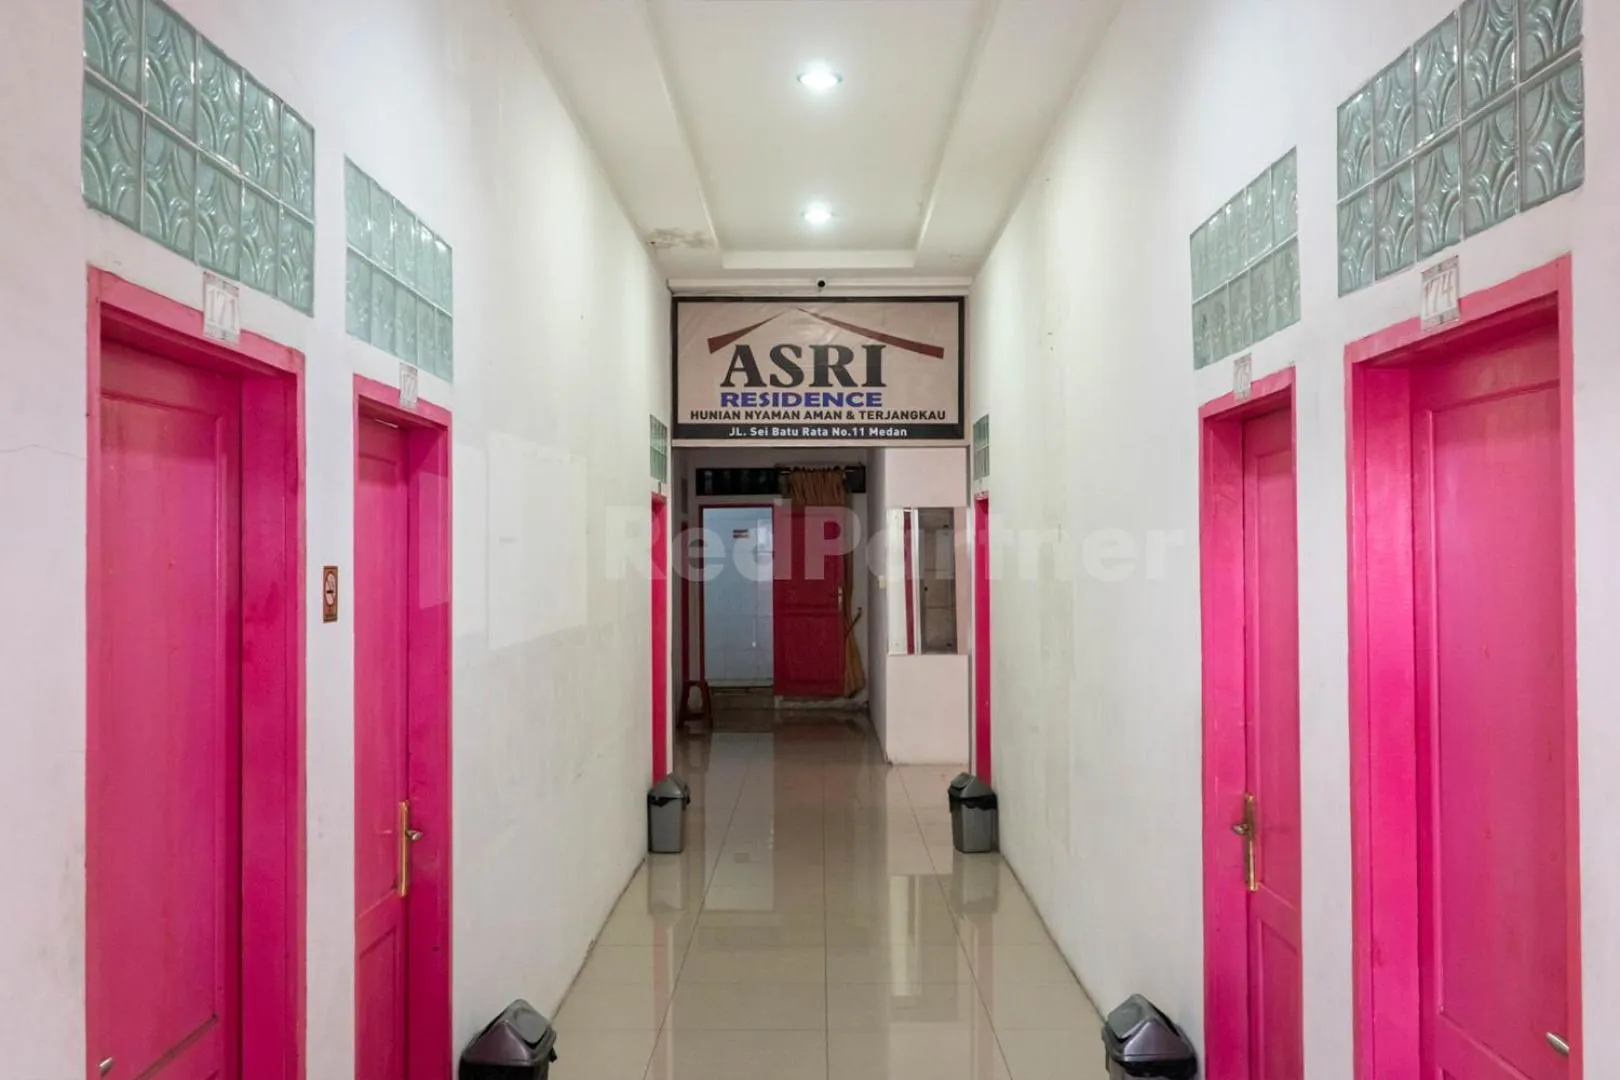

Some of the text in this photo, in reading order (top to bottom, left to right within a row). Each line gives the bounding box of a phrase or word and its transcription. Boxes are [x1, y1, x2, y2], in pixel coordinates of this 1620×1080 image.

[720, 343, 887, 388] ASRI
[720, 391, 883, 408] RESIDENCE
[690, 410, 946, 421] HUNIAN NYAMAN AMAN & TERJANGKAU
[728, 426, 908, 437] JL. Sei Batu Rata No.11 Medan
